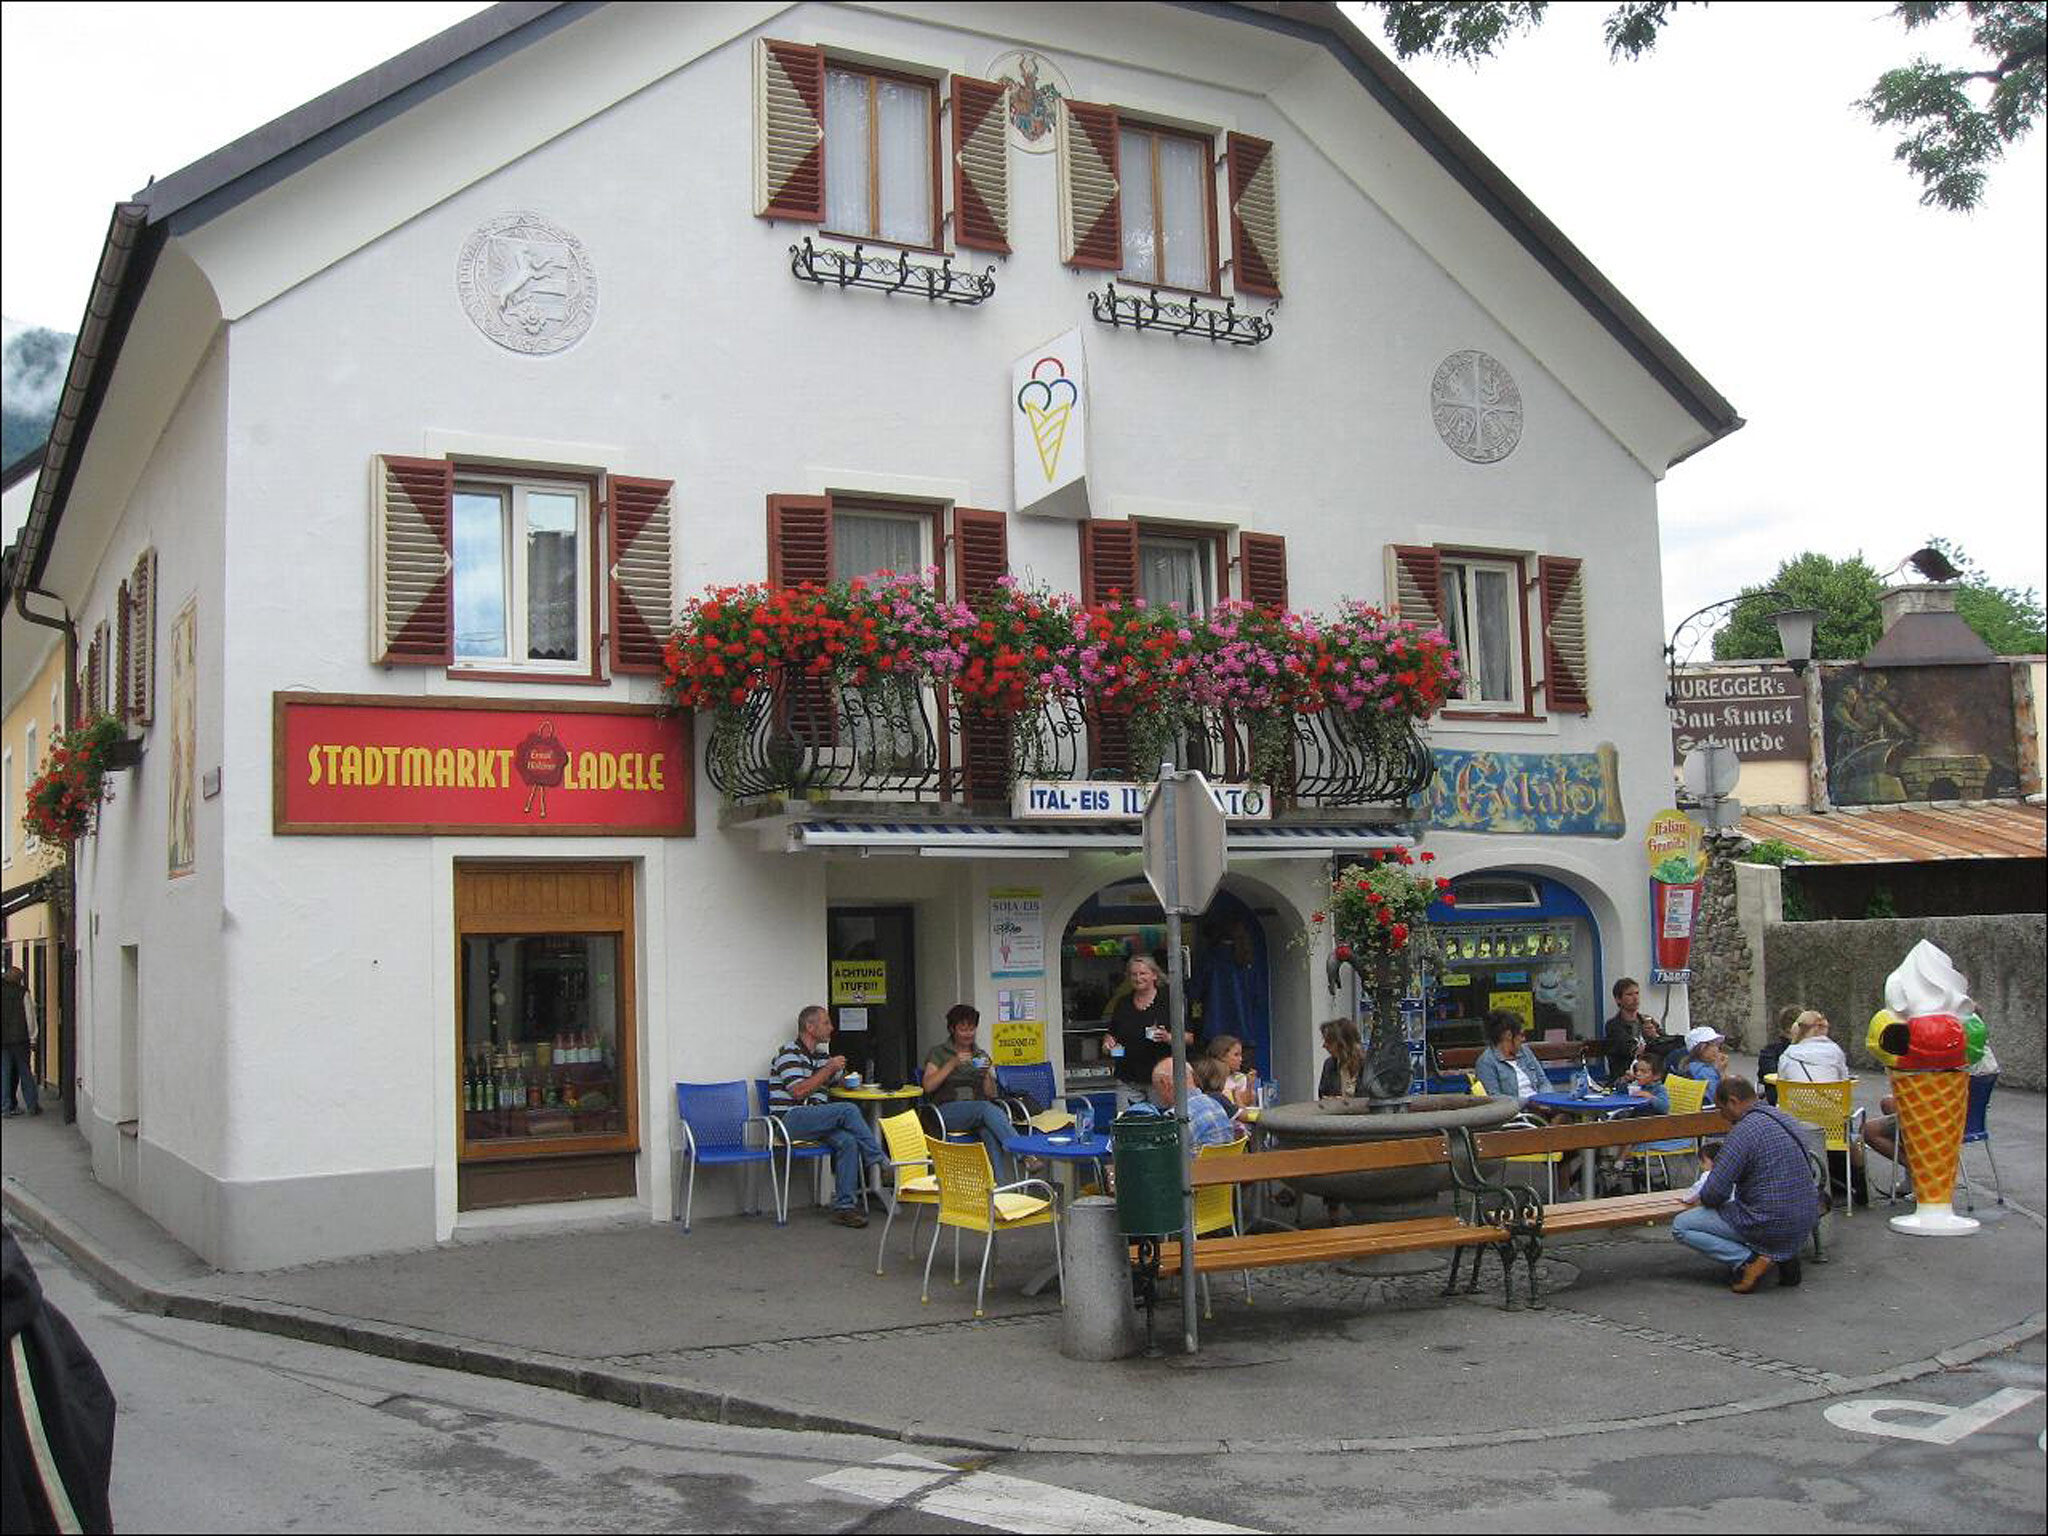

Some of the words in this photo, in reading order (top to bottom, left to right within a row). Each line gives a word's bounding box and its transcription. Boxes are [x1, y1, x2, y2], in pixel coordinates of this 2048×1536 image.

[307, 744, 514, 788] STADTMARKT
[563, 750, 666, 791] LADELE
[1030, 789, 1110, 811] ITAL-EIS
[834, 967, 884, 978] ACHTUNG
